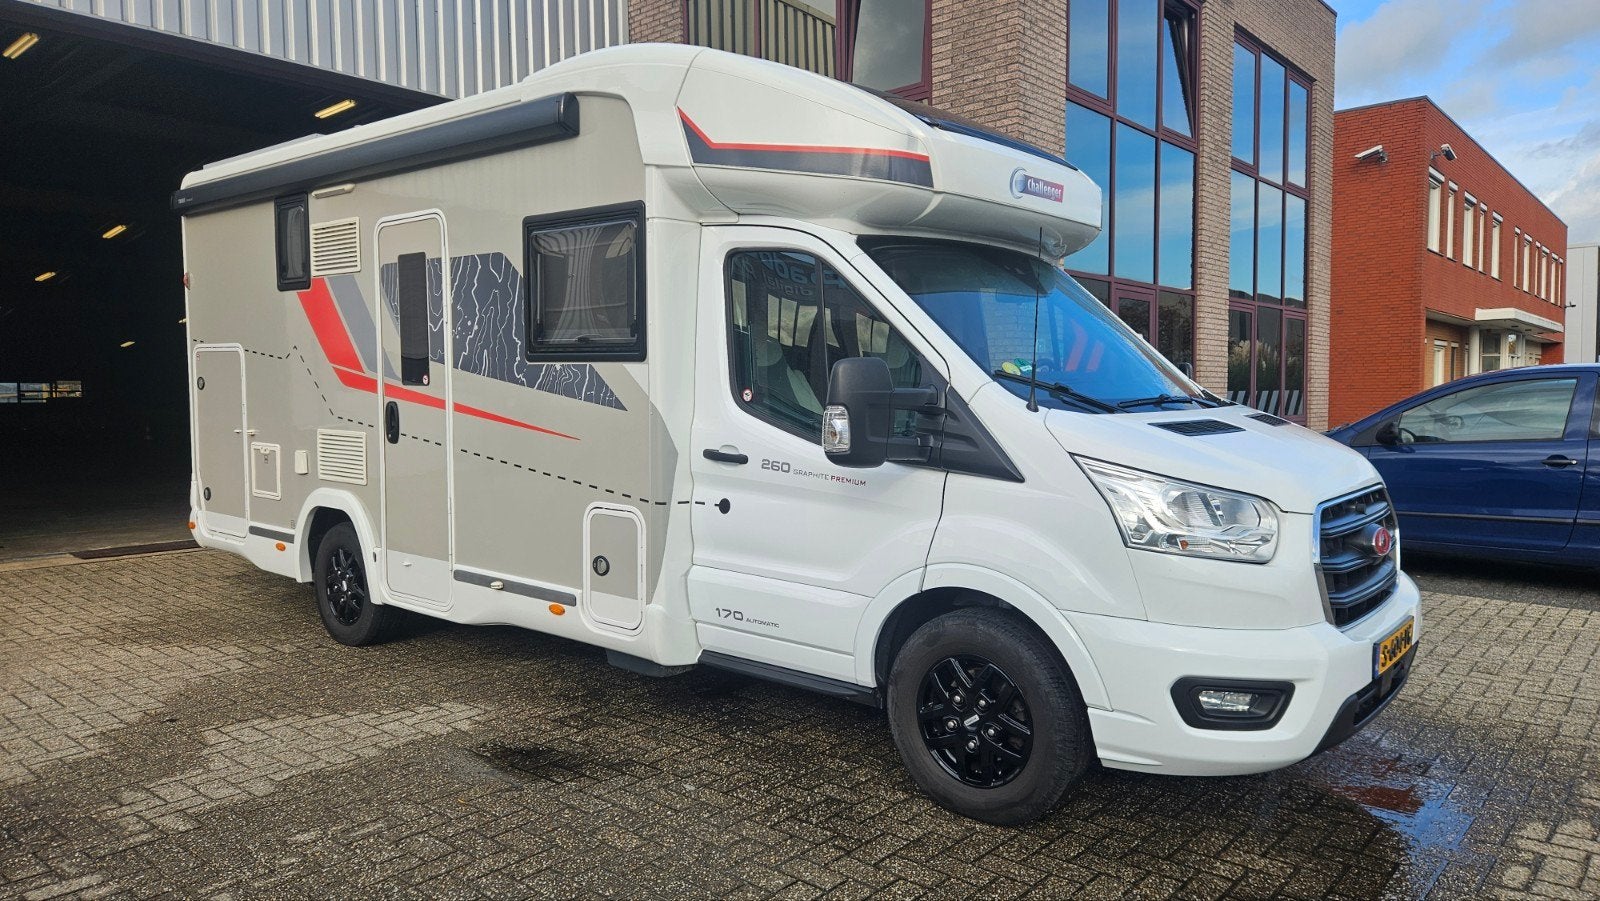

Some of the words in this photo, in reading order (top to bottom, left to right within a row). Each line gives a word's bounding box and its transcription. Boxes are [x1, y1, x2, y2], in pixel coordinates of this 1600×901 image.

[1027, 178, 1062, 200] Challenger
[761, 458, 791, 473] 260
[830, 475, 866, 486] PREMIUM
[715, 607, 744, 621] 170
[746, 618, 780, 628] AUTOMATIC
